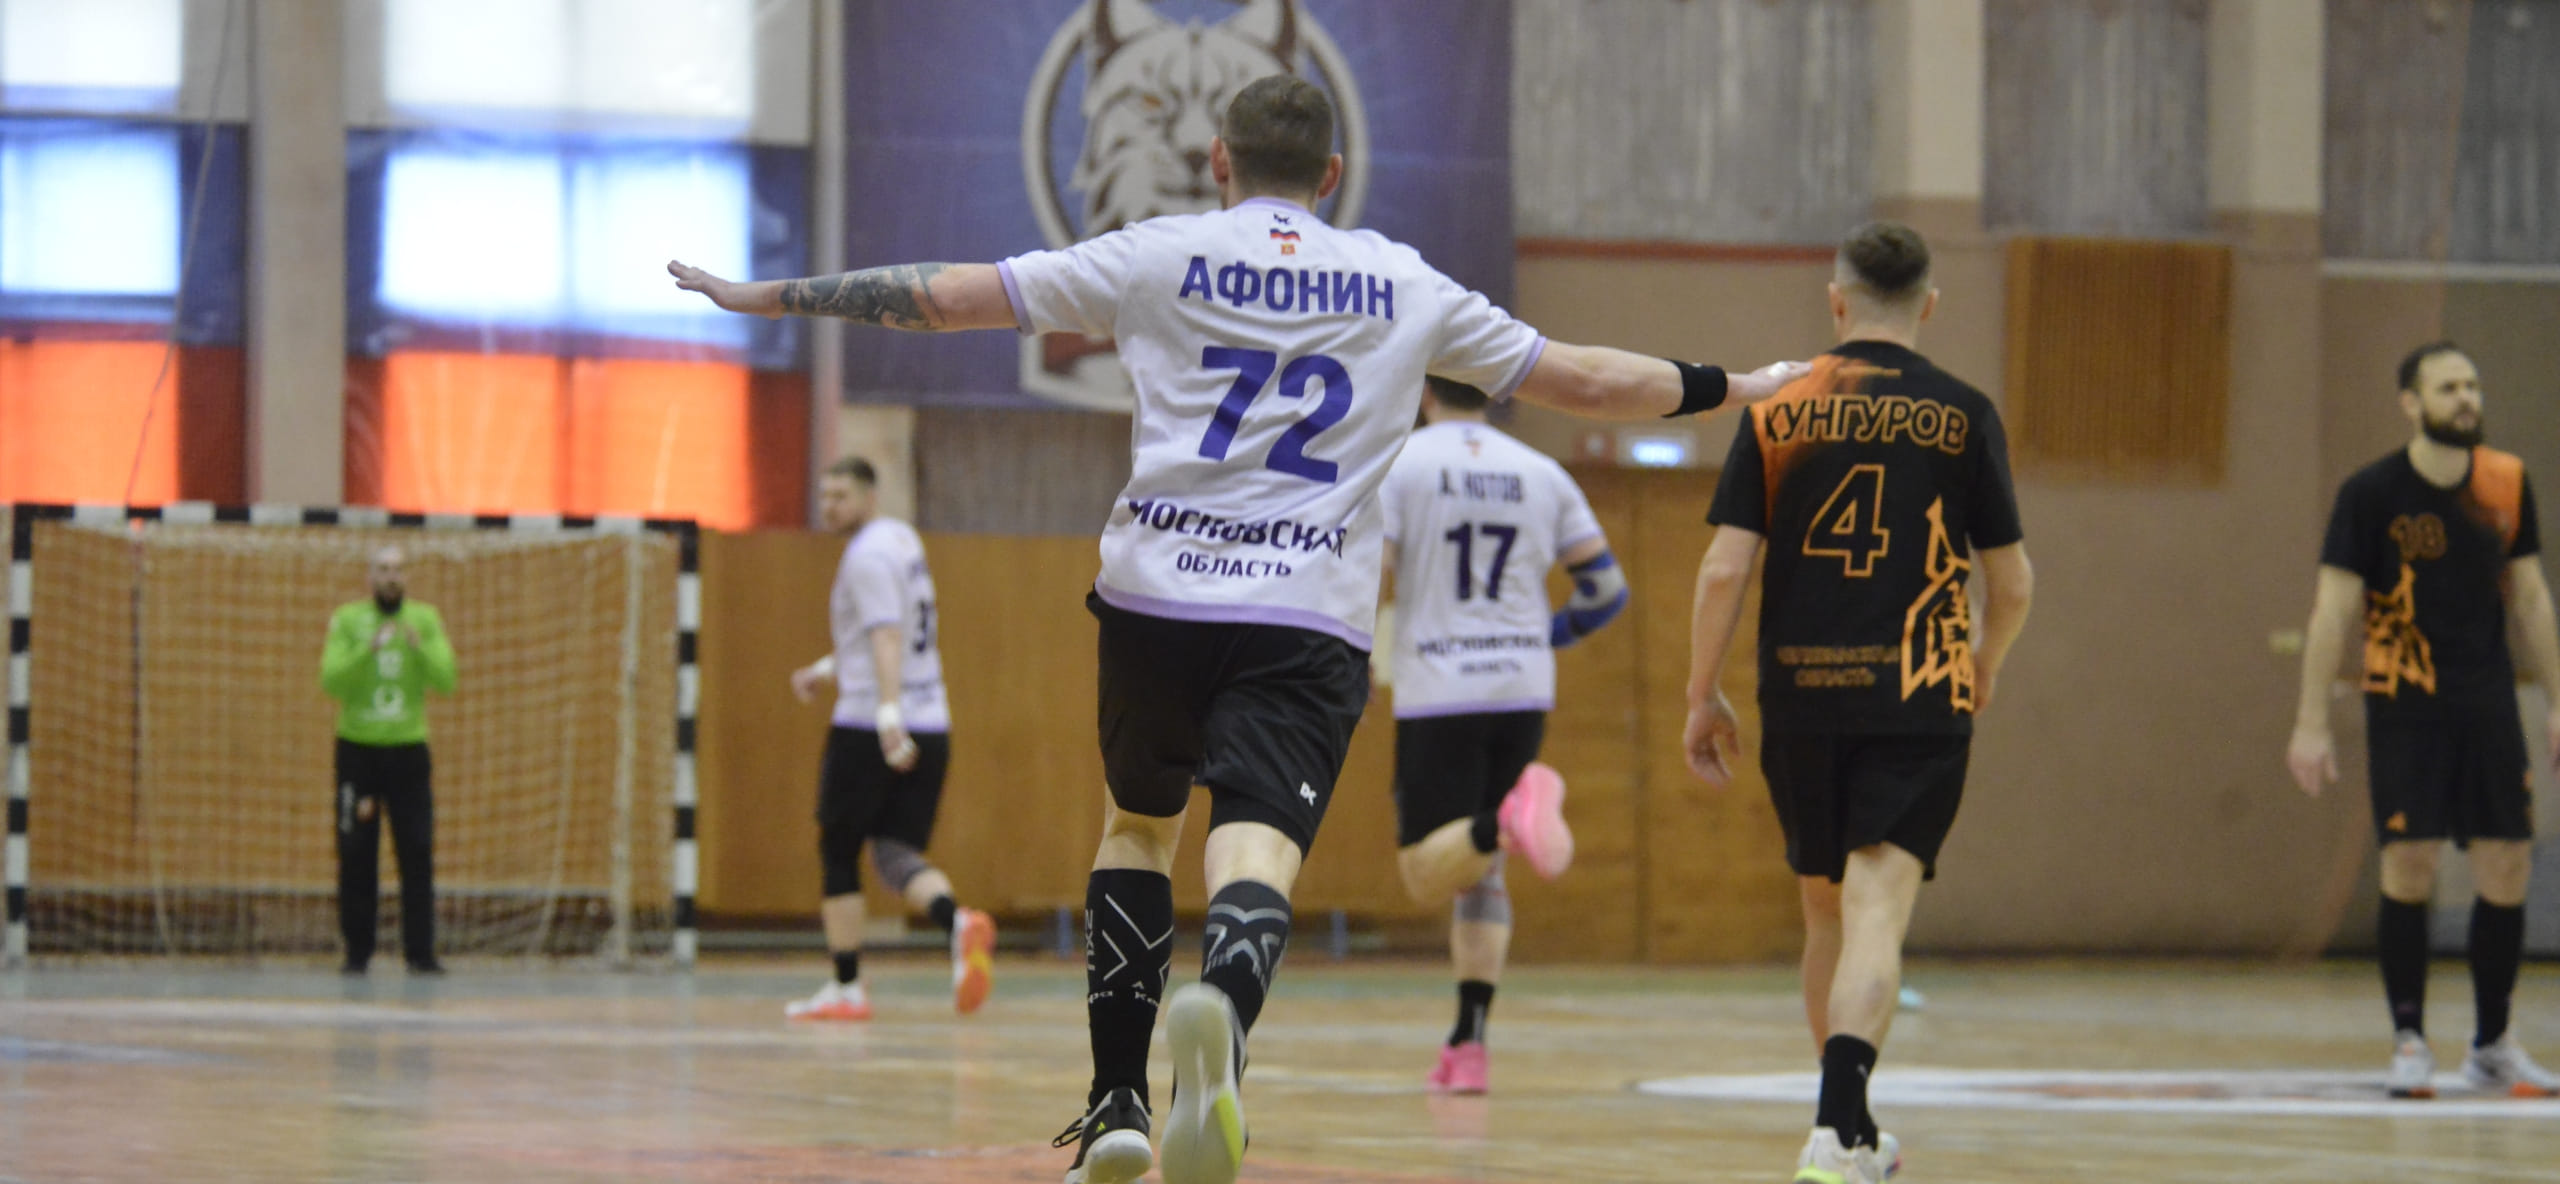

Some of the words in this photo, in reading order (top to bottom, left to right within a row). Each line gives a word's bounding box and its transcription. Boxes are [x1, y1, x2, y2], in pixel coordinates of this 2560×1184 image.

[1179, 256, 1395, 322] АФОНИН
[1198, 345, 1354, 484] 72
[1765, 393, 1969, 455] КУНГУРОВ
[1802, 463, 1891, 578] 4
[1176, 551, 1293, 578] ОБЛАСТЬ
[1444, 520, 1518, 602] 17
